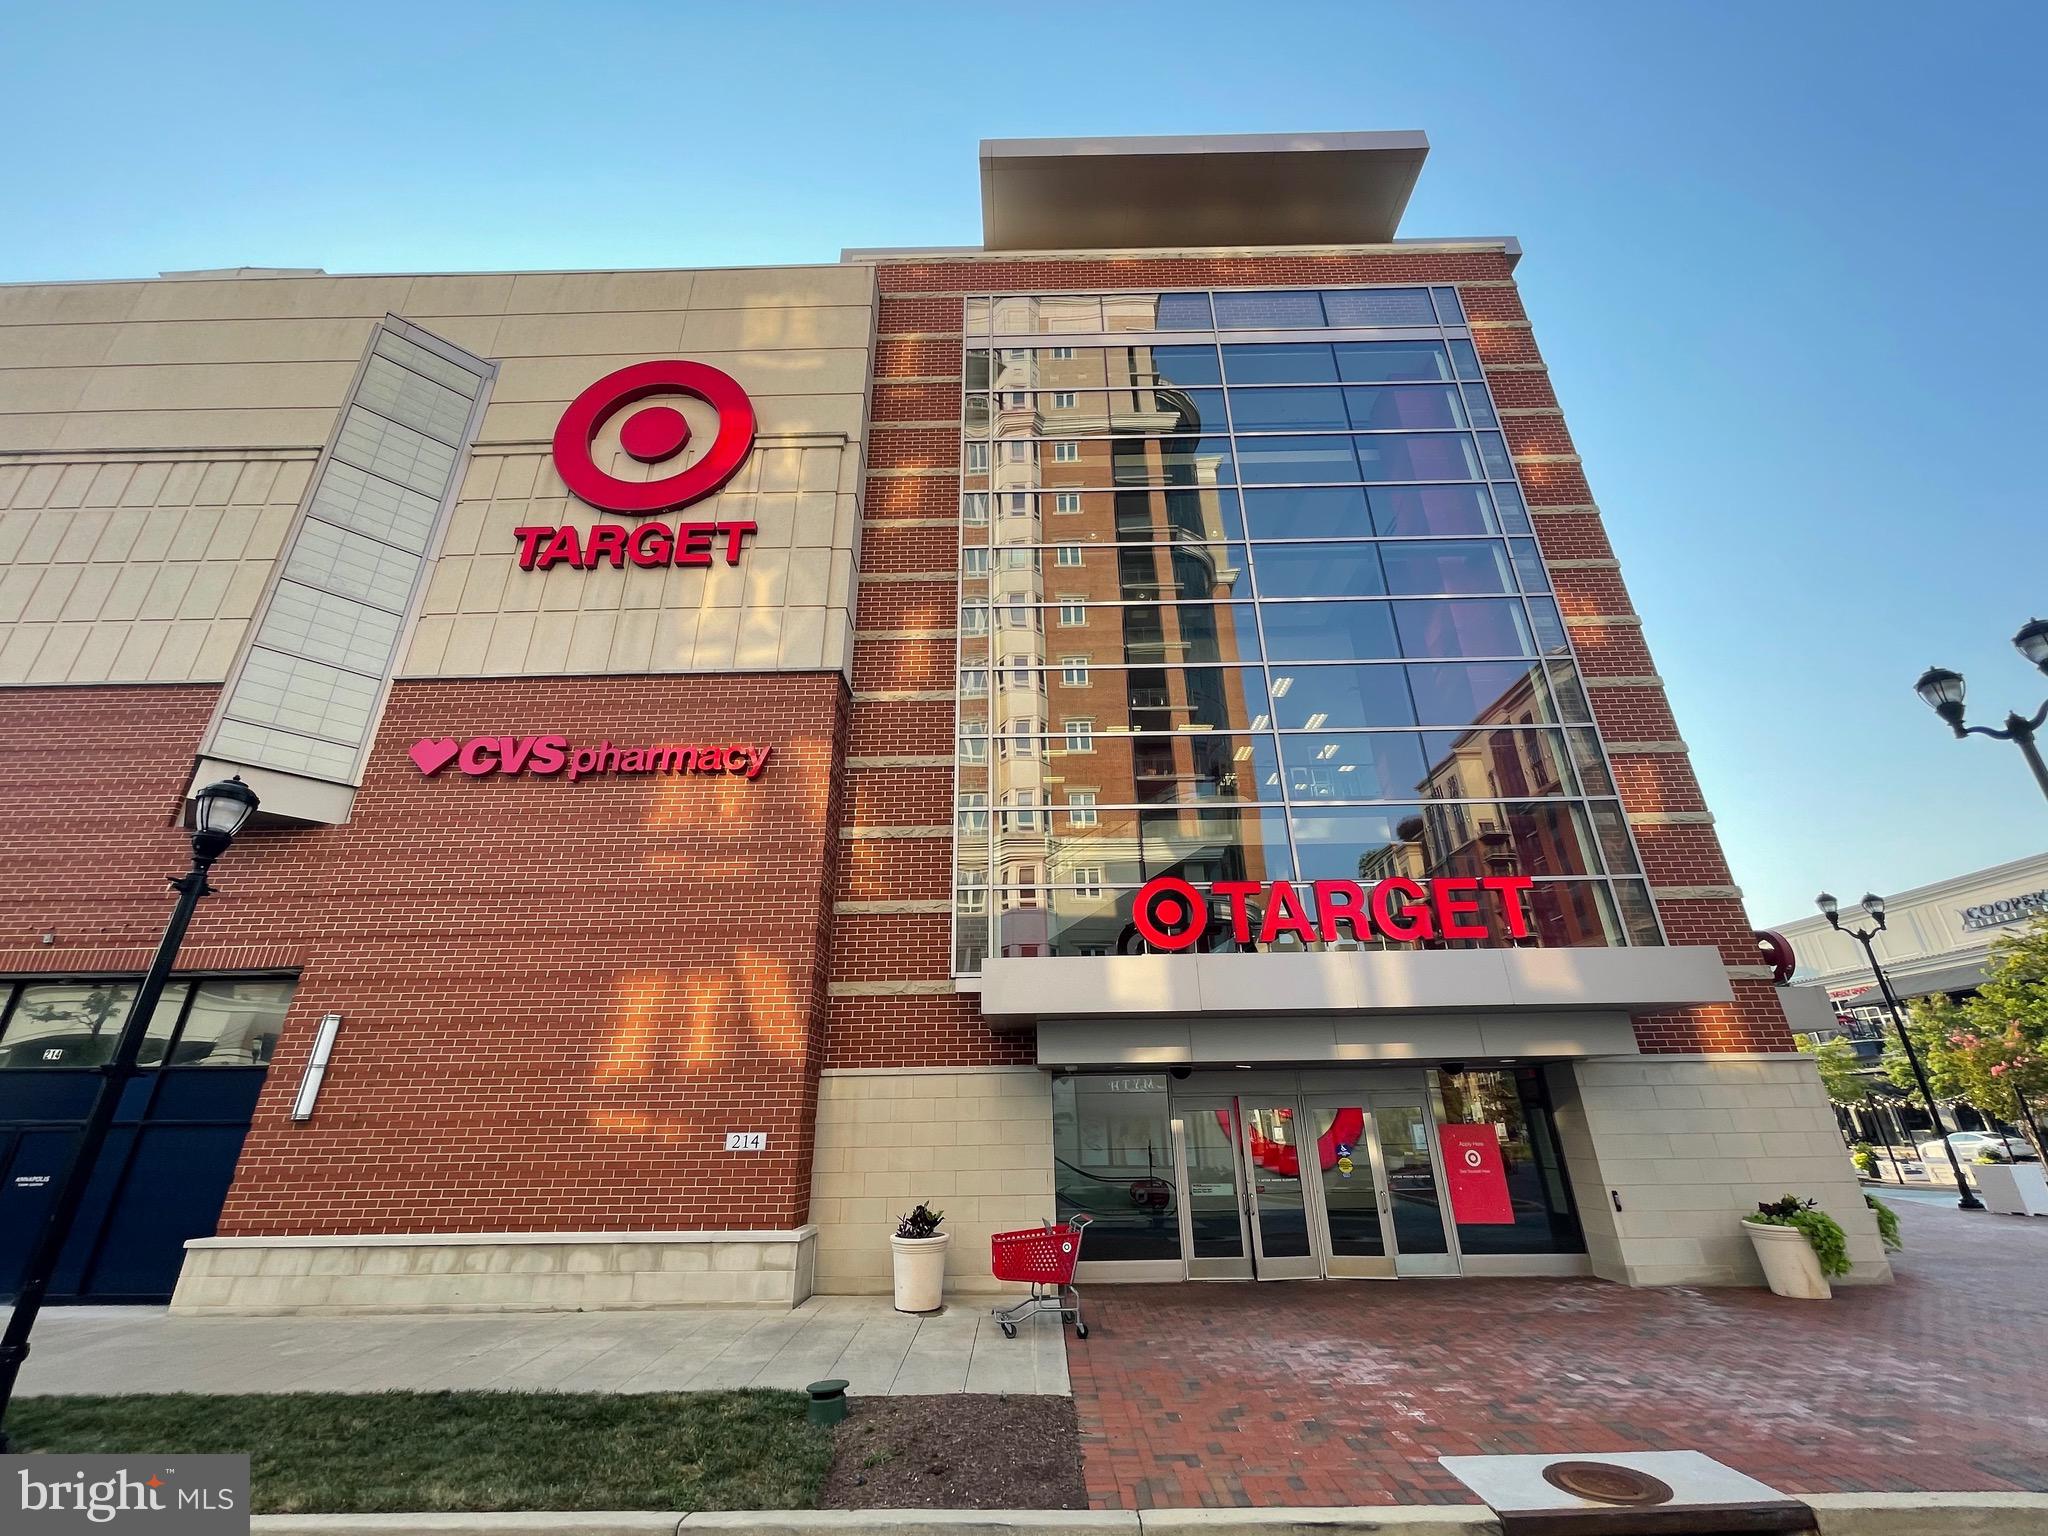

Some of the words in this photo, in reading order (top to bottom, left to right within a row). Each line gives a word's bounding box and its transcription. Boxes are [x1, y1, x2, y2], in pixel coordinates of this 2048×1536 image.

[513, 521, 758, 572] TARGET
[458, 735, 570, 778] CVS
[568, 740, 772, 783] pharmacy
[1211, 875, 1533, 944] TARGET
[731, 1134, 760, 1149] 214
